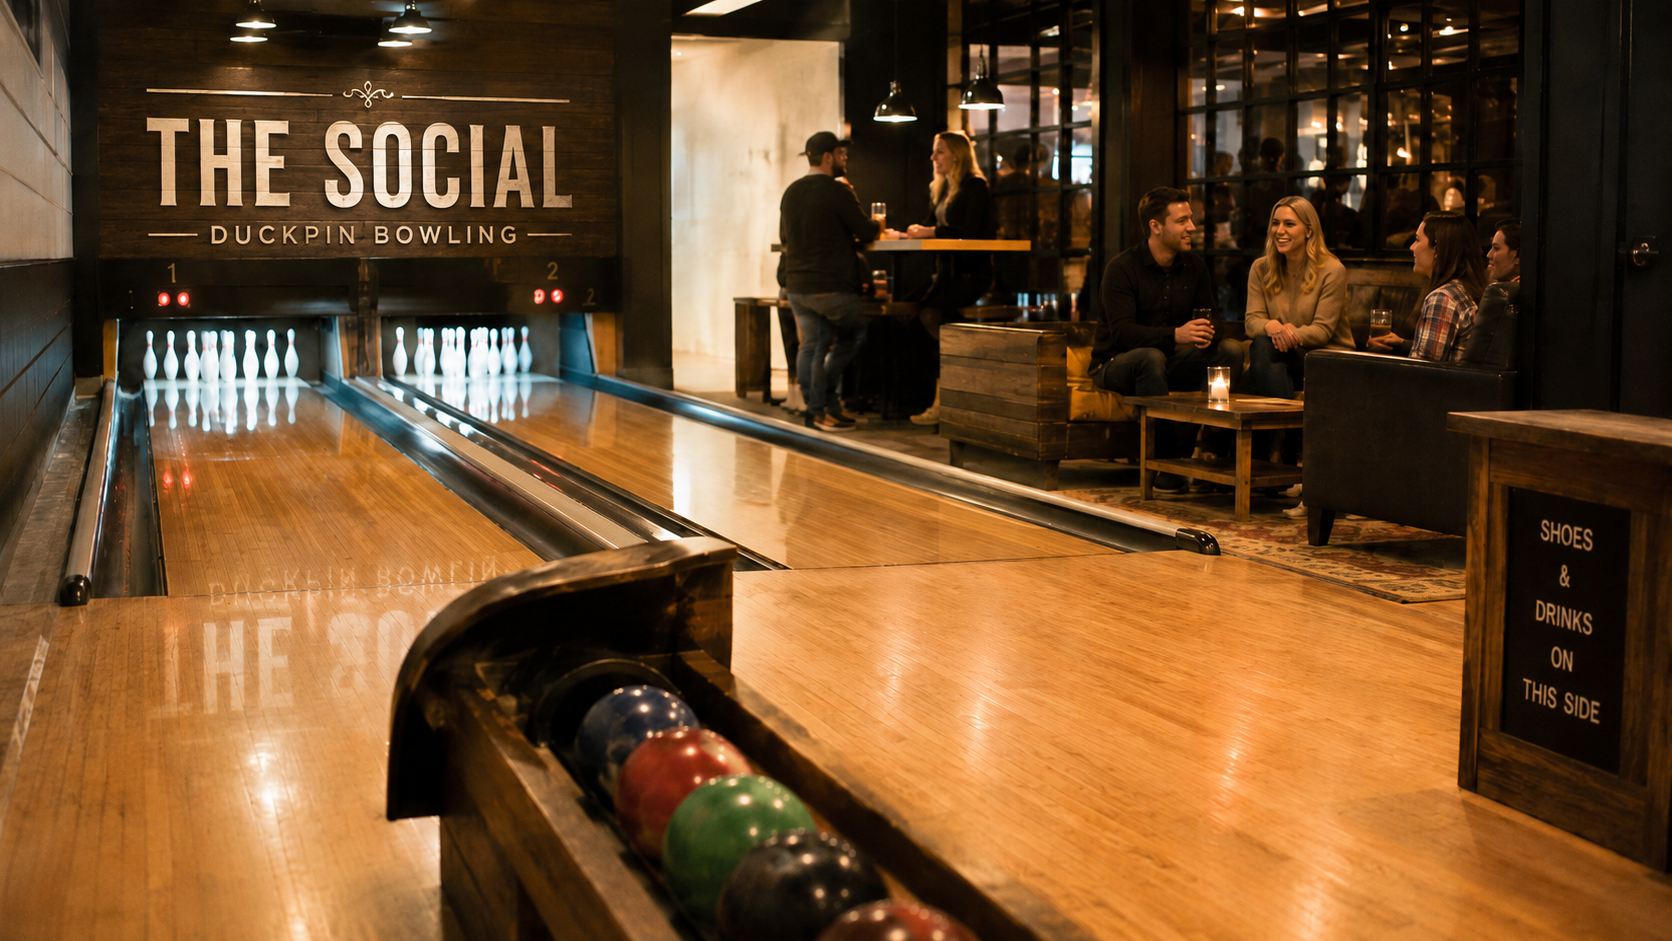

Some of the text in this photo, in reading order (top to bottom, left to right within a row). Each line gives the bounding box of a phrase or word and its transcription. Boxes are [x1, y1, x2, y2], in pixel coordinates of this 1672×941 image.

[146, 117, 573, 209] THE SOCIAL
[210, 225, 517, 245] DUCKPIN BOWLING
[167, 262, 177, 284] 1
[547, 261, 559, 281] 2
[1540, 519, 1593, 551] SHOES
[1559, 564, 1571, 588] &
[1535, 599, 1593, 635] DRINKS
[1550, 646, 1574, 672] ON
[1523, 678, 1600, 724] THIS SIDE
